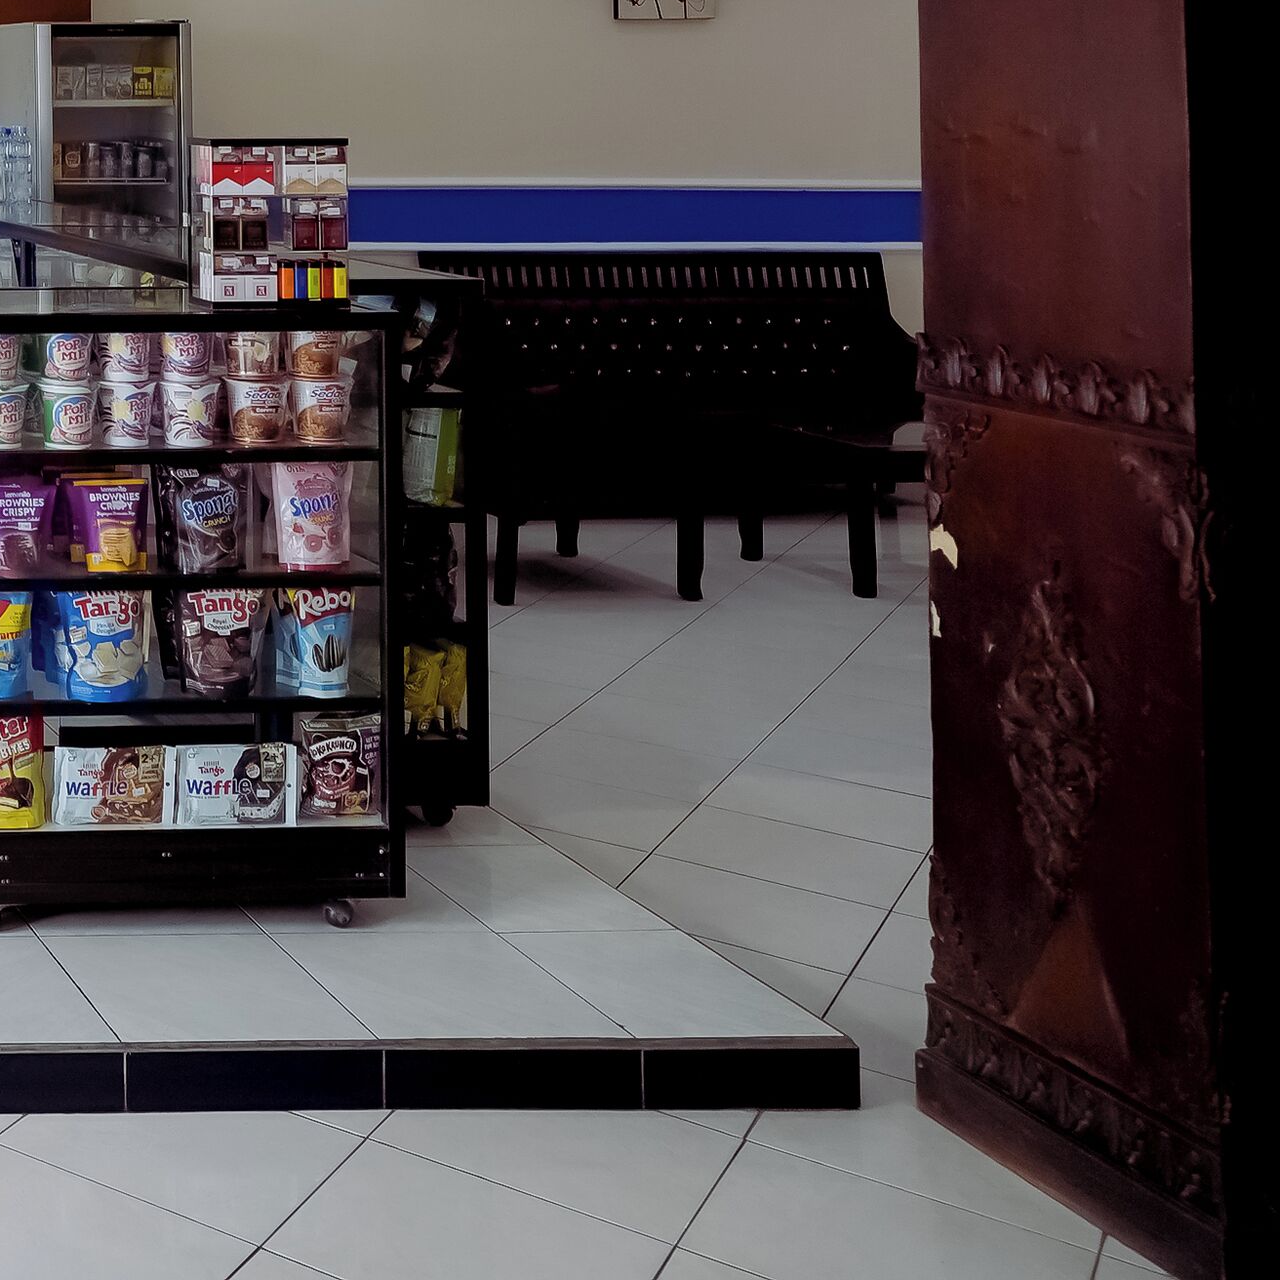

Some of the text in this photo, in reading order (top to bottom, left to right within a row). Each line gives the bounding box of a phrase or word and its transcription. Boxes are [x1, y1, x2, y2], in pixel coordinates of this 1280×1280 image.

[57, 339, 80, 353] POP
[174, 333, 199, 348] POP
[63, 402, 86, 417] POP
[89, 492, 141, 502] BROWNIES
[2, 507, 36, 517] CRISPY
[289, 492, 338, 519] Spong
[188, 592, 258, 622] Tango
[297, 587, 351, 619] Rebo
[74, 597, 139, 625] Tango
[0, 738, 30, 759] BITES
[77, 768, 105, 778] Tango
[198, 766, 225, 777] Tango
